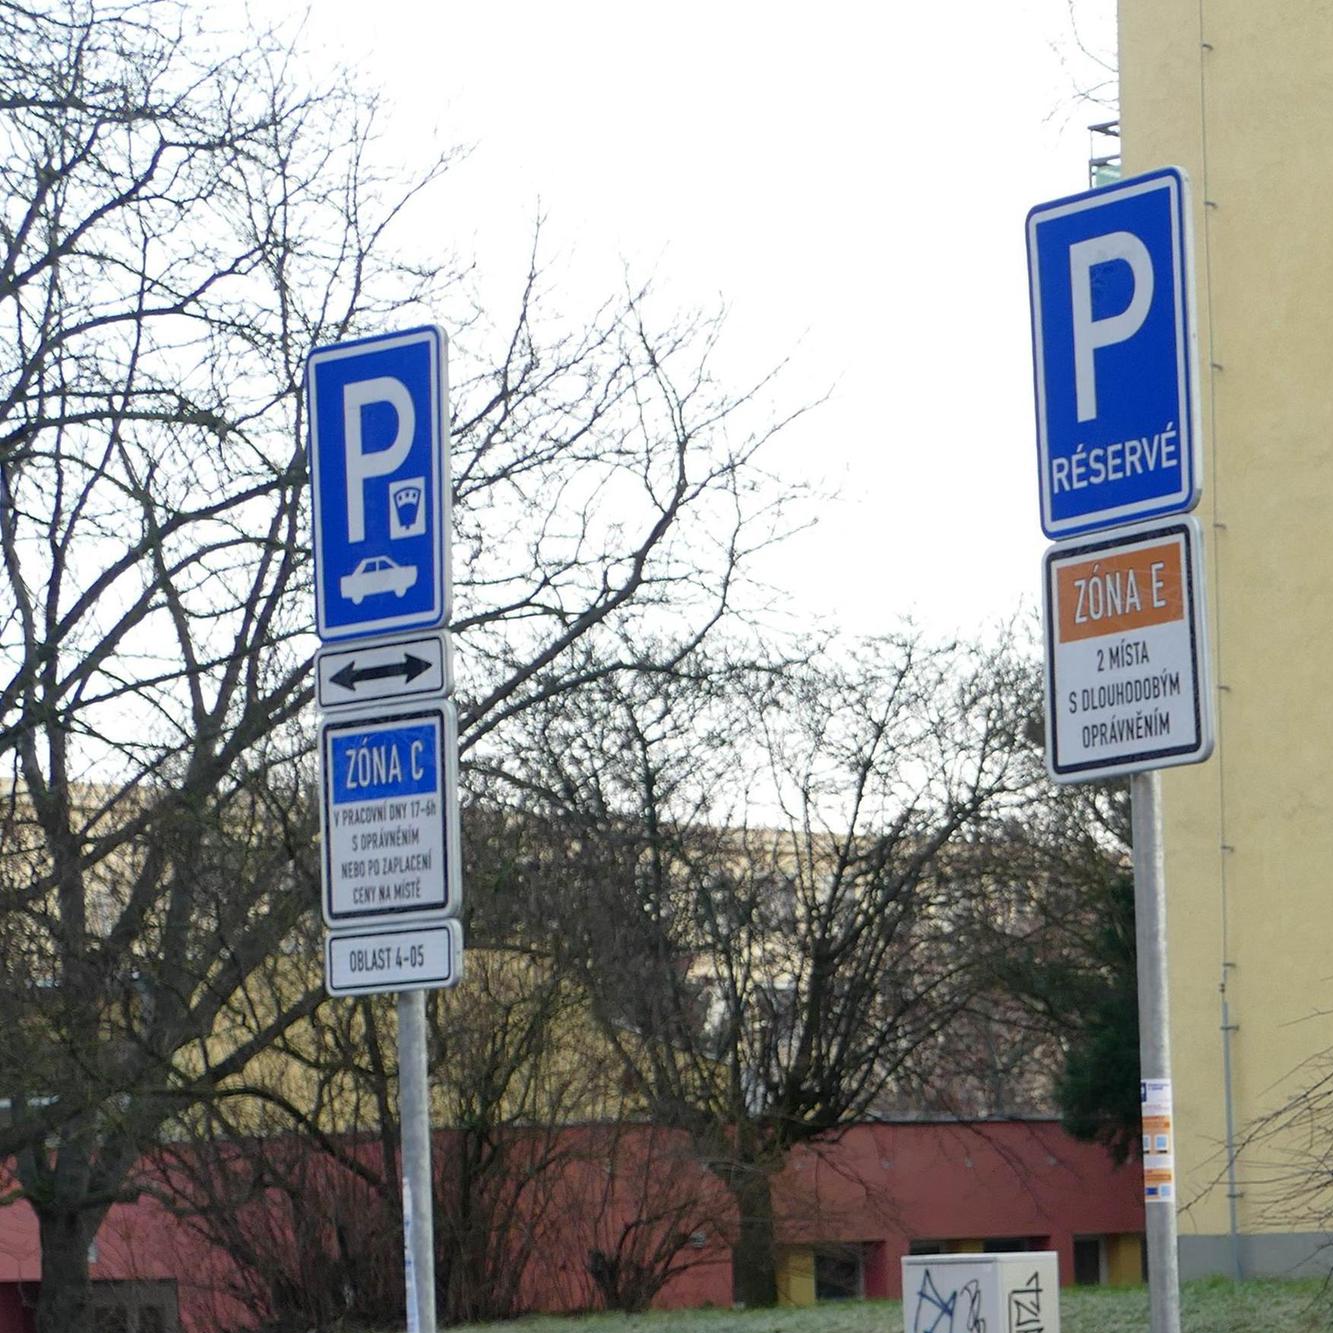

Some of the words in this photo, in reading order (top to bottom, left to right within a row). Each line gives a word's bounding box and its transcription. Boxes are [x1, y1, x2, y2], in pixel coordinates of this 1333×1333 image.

[1069, 230, 1154, 424] P
[343, 375, 416, 544] P
[1051, 422, 1178, 495] RÉSERVÉ
[1074, 564, 1142, 625] ZÓNA
[1151, 562, 1167, 609] E
[1096, 649, 1105, 673] 2
[1108, 638, 1150, 670] MÍSTA
[1068, 692, 1078, 714] S
[1082, 669, 1181, 713] DLOUHODOBÝM
[1082, 708, 1170, 749] OPRÁVNĚNÍM
[345, 737, 402, 790] ZÓNA
[410, 740, 425, 782] C
[333, 810, 342, 828] V
[342, 800, 388, 826] PRACOVNÍ
[389, 802, 408, 820] DNY
[410, 800, 437, 819] 17-6h
[352, 834, 360, 852] S
[341, 859, 366, 880] NEBO
[367, 858, 381, 877] PO
[382, 848, 432, 876] ZAPLACENÍ
[352, 885, 376, 905] CENY
[378, 884, 391, 902] NA
[349, 947, 392, 973] OBLAST
[394, 944, 425, 970] 4-05
